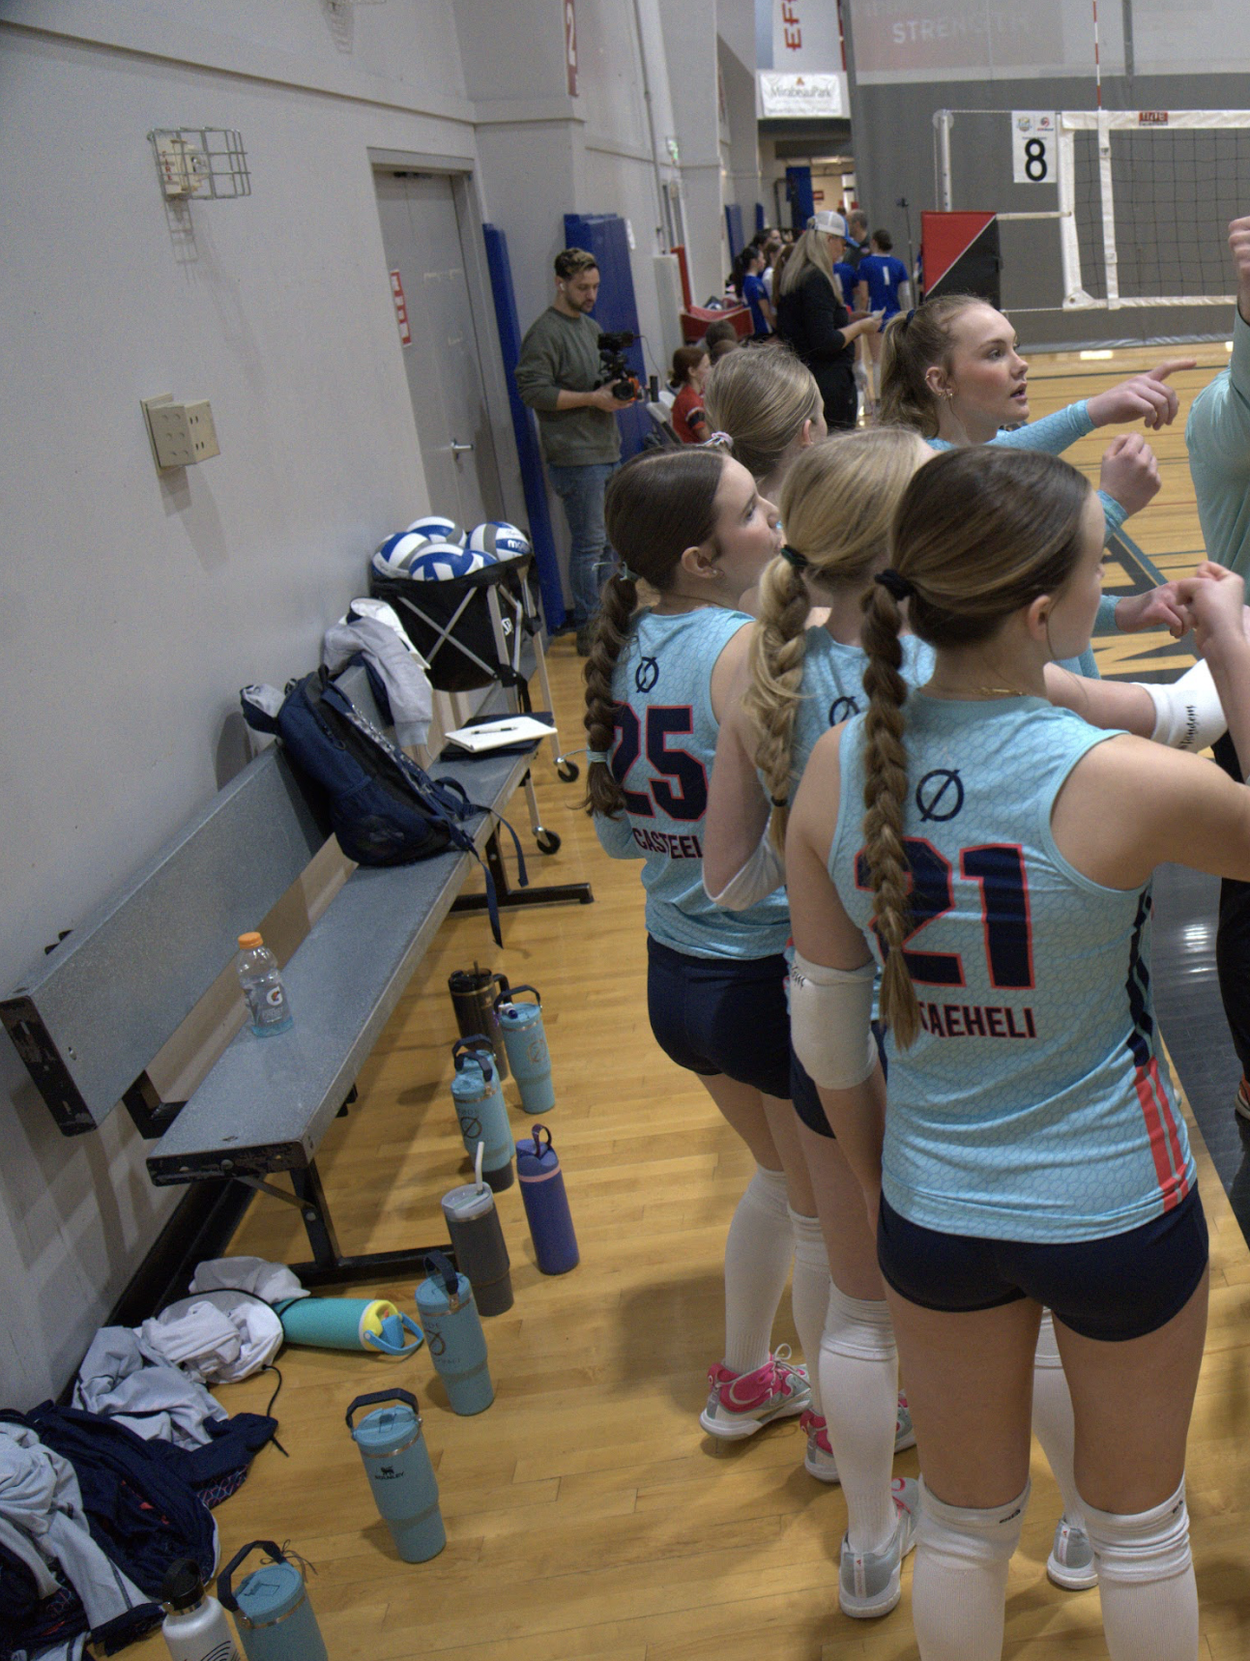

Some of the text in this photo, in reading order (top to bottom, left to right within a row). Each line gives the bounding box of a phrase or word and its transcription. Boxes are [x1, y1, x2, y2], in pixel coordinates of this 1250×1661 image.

[1025, 138, 1047, 182] 8
[610, 700, 709, 822] 25
[854, 836, 1035, 990] 21
